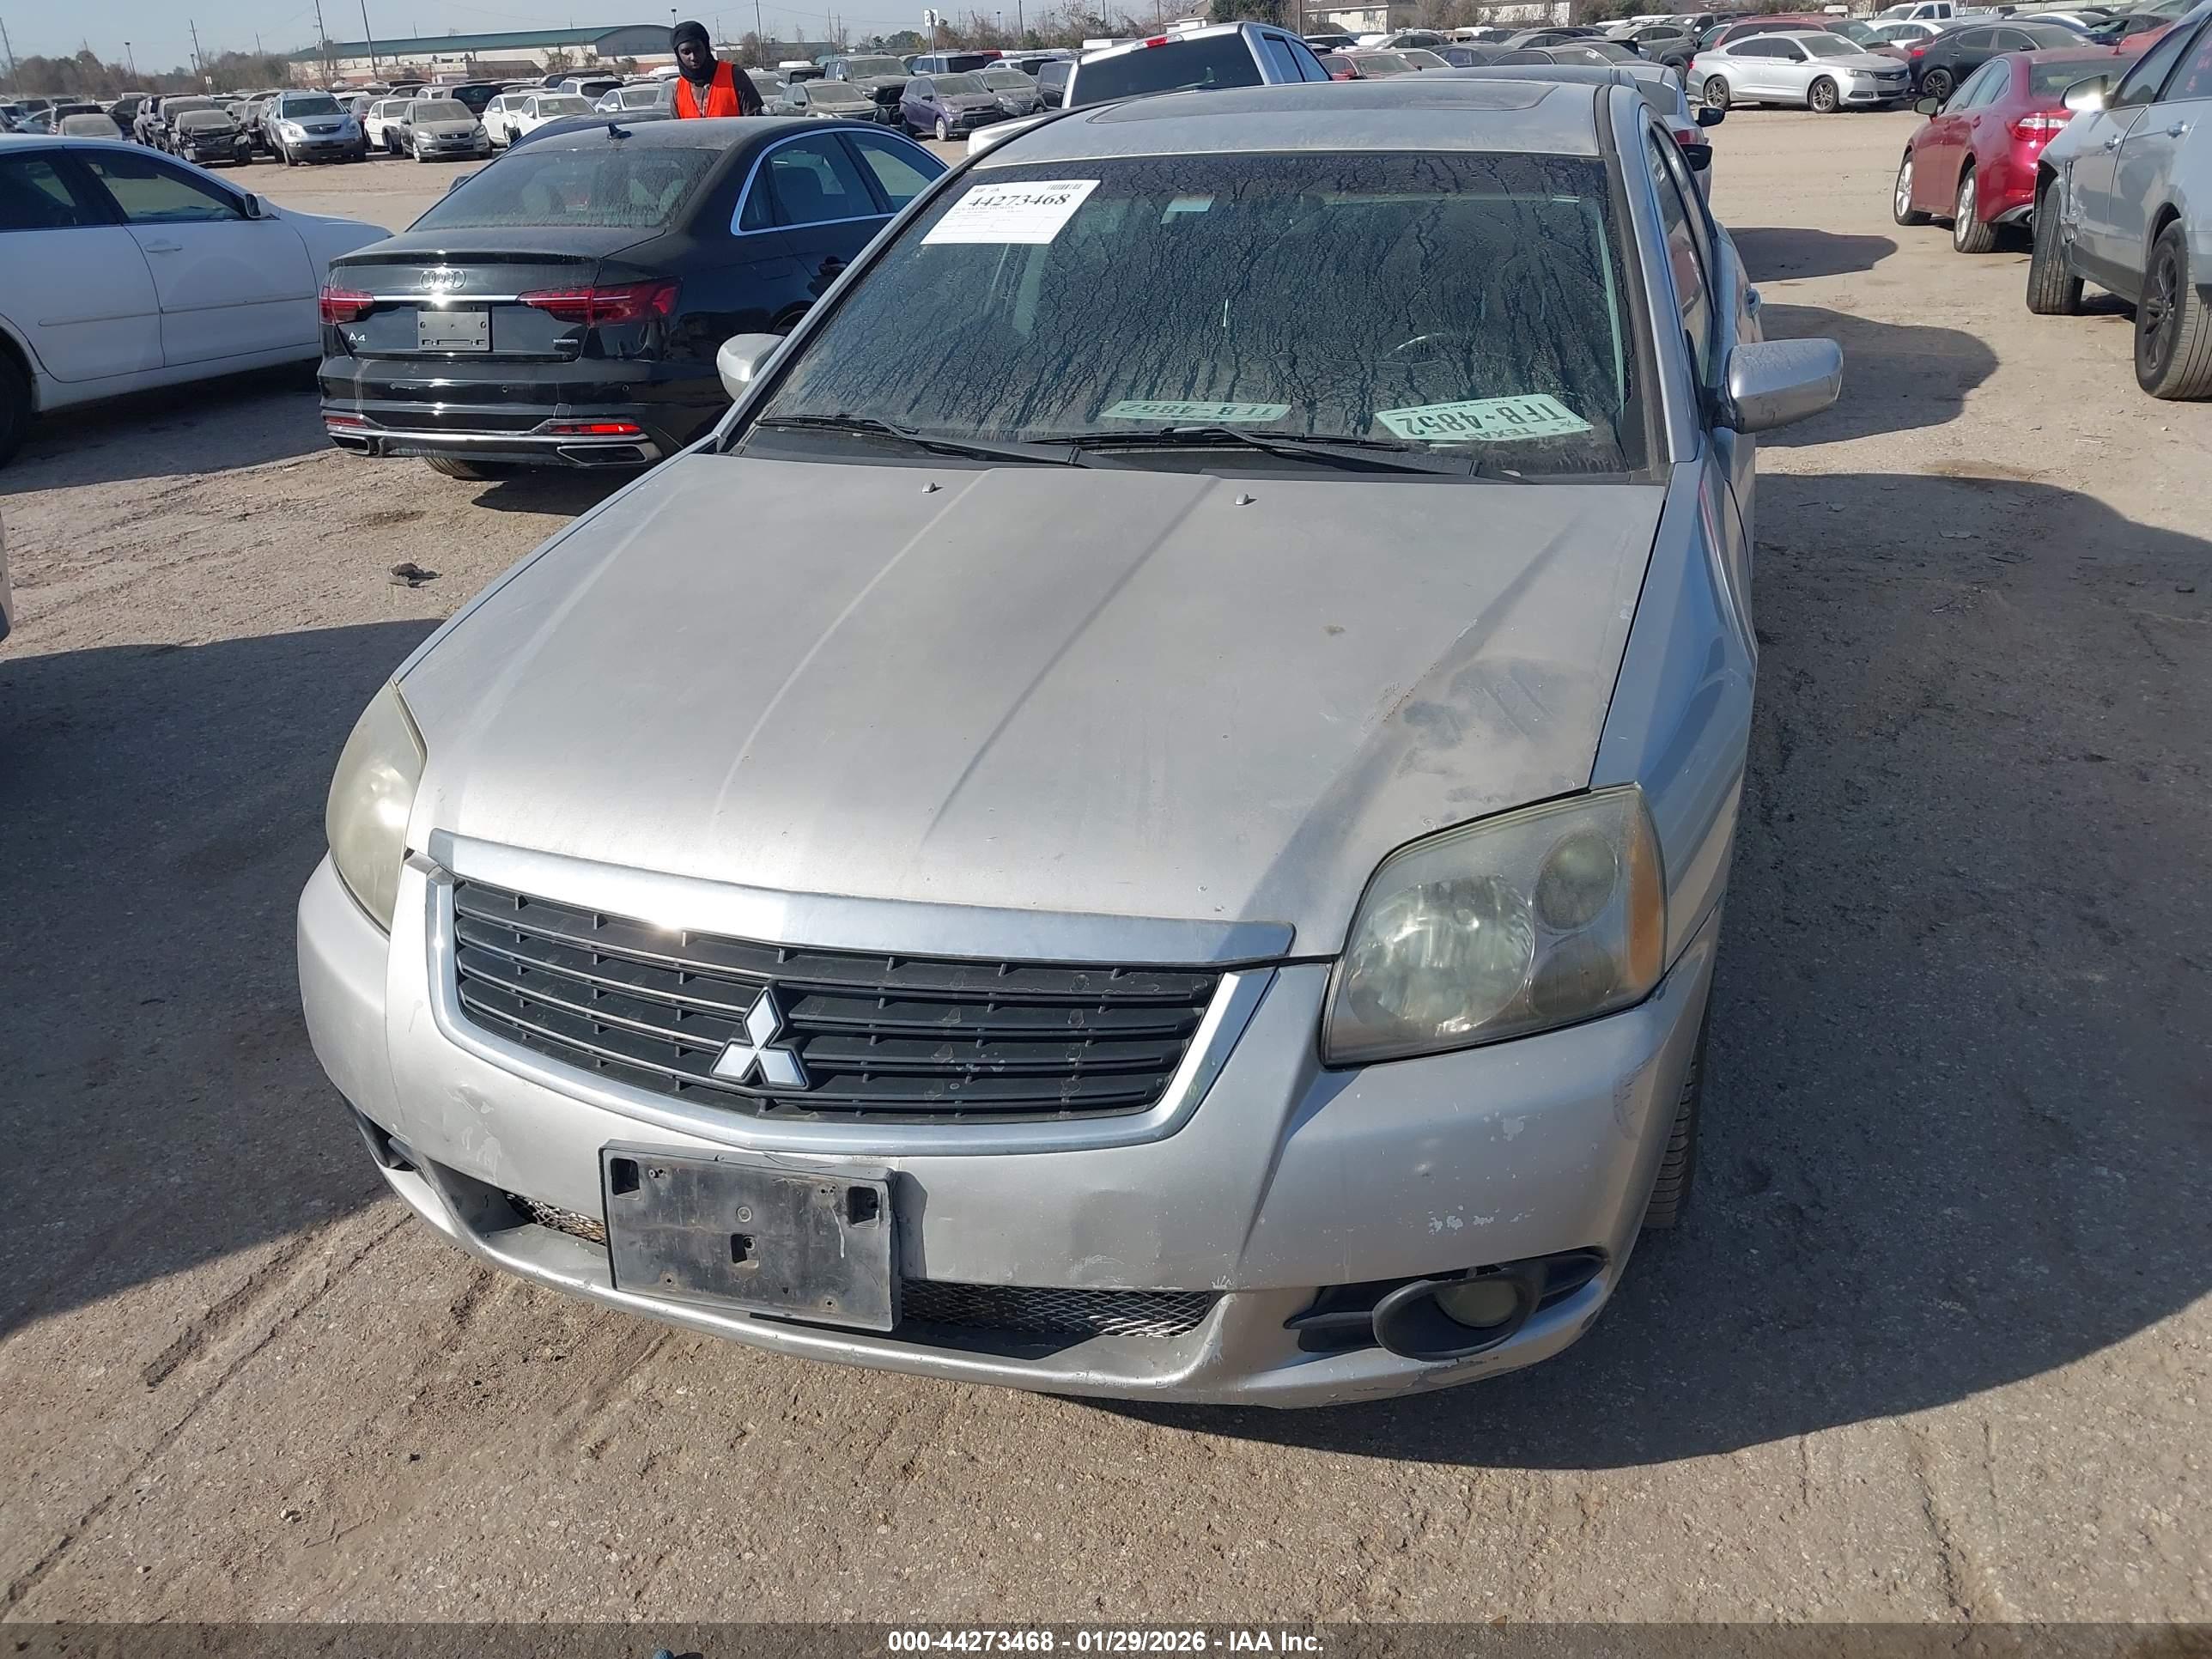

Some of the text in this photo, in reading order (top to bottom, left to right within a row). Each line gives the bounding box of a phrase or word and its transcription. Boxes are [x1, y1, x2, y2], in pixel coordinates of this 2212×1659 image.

[969, 194, 1071, 206] 44273468
[349, 331, 366, 343] A4
[1464, 428, 1538, 440] TEXAS
